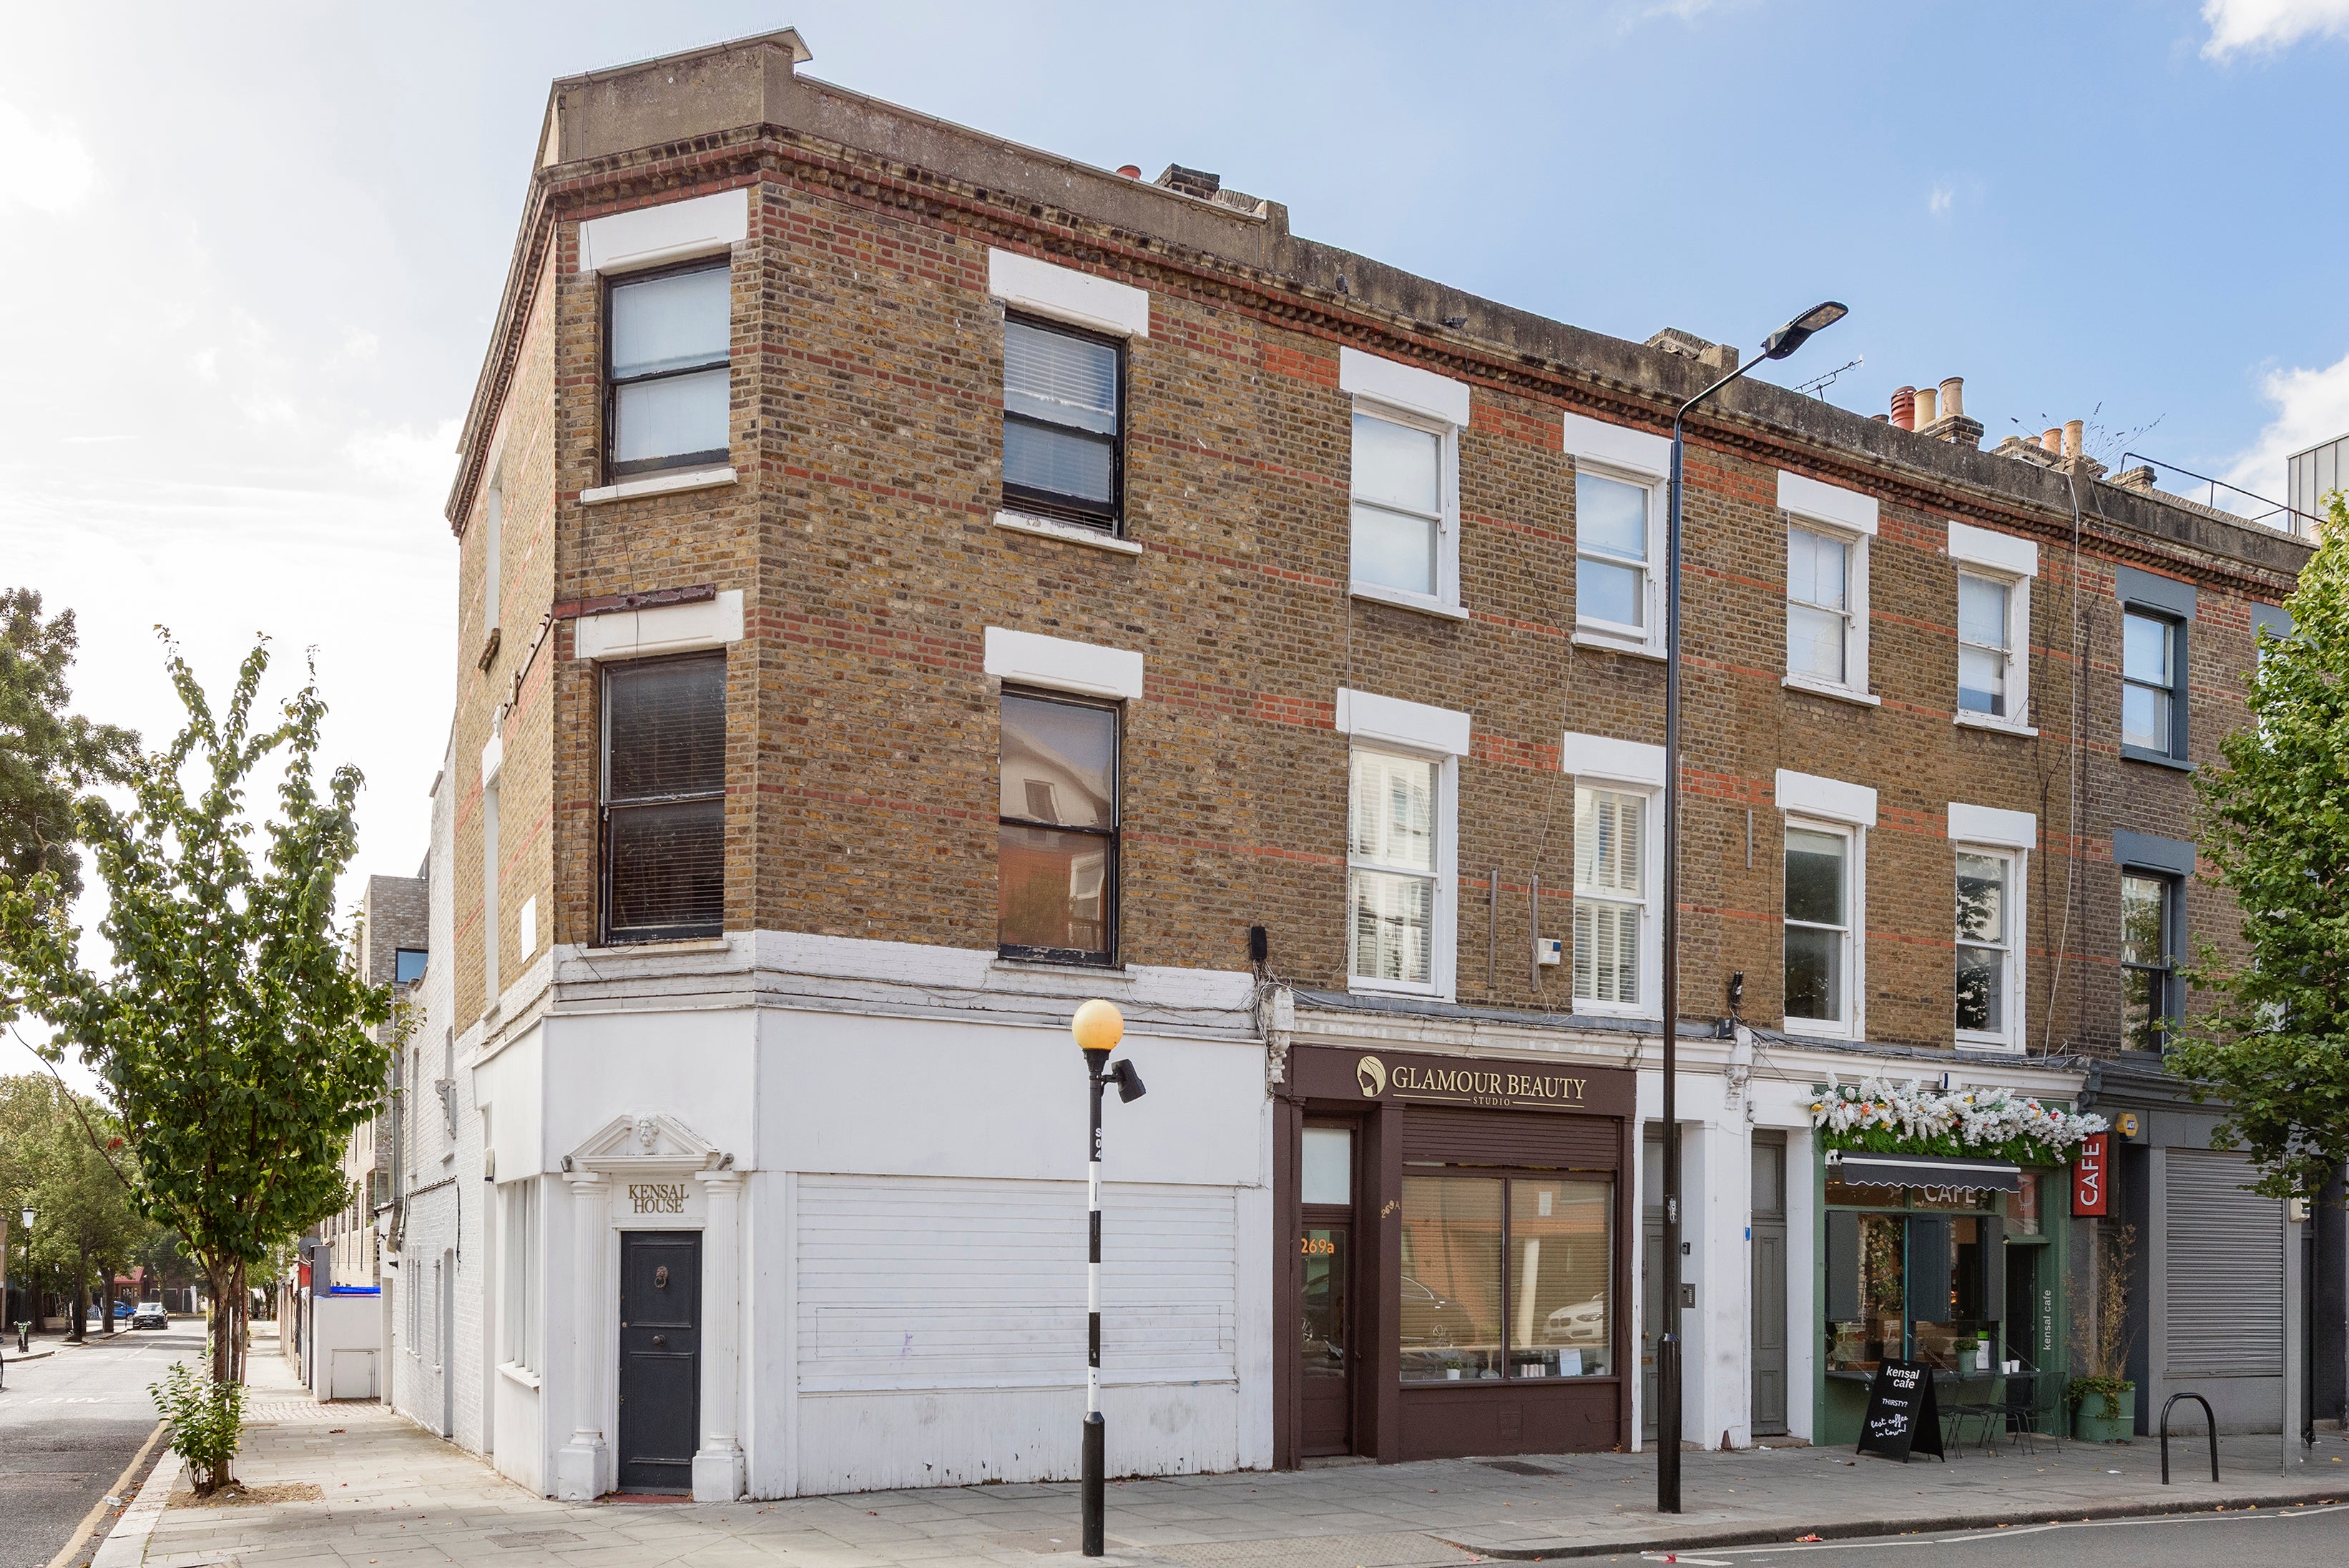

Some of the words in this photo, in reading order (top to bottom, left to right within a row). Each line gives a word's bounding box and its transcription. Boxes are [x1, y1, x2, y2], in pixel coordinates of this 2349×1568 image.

[1391, 1066, 1503, 1094] GLAMOUR
[1506, 1074, 1587, 1099] BEAUTY
[1473, 1096, 1510, 1106] STUDIO
[2080, 1142, 2099, 1207] CAFE
[628, 1184, 690, 1199] KENSAL
[633, 1198, 684, 1213] HOUSE
[1300, 1238, 1335, 1254] 269a
[2043, 1290, 2051, 1312] cafe
[2043, 1315, 2051, 1351] kensal
[1886, 1366, 1920, 1380] kensal
[1893, 1378, 1915, 1388] cafe
[1882, 1398, 1908, 1408] THIRSTY?
[1870, 1418, 1887, 1429] best
[1888, 1413, 1908, 1428] coffee
[1885, 1424, 1906, 1436] town!
